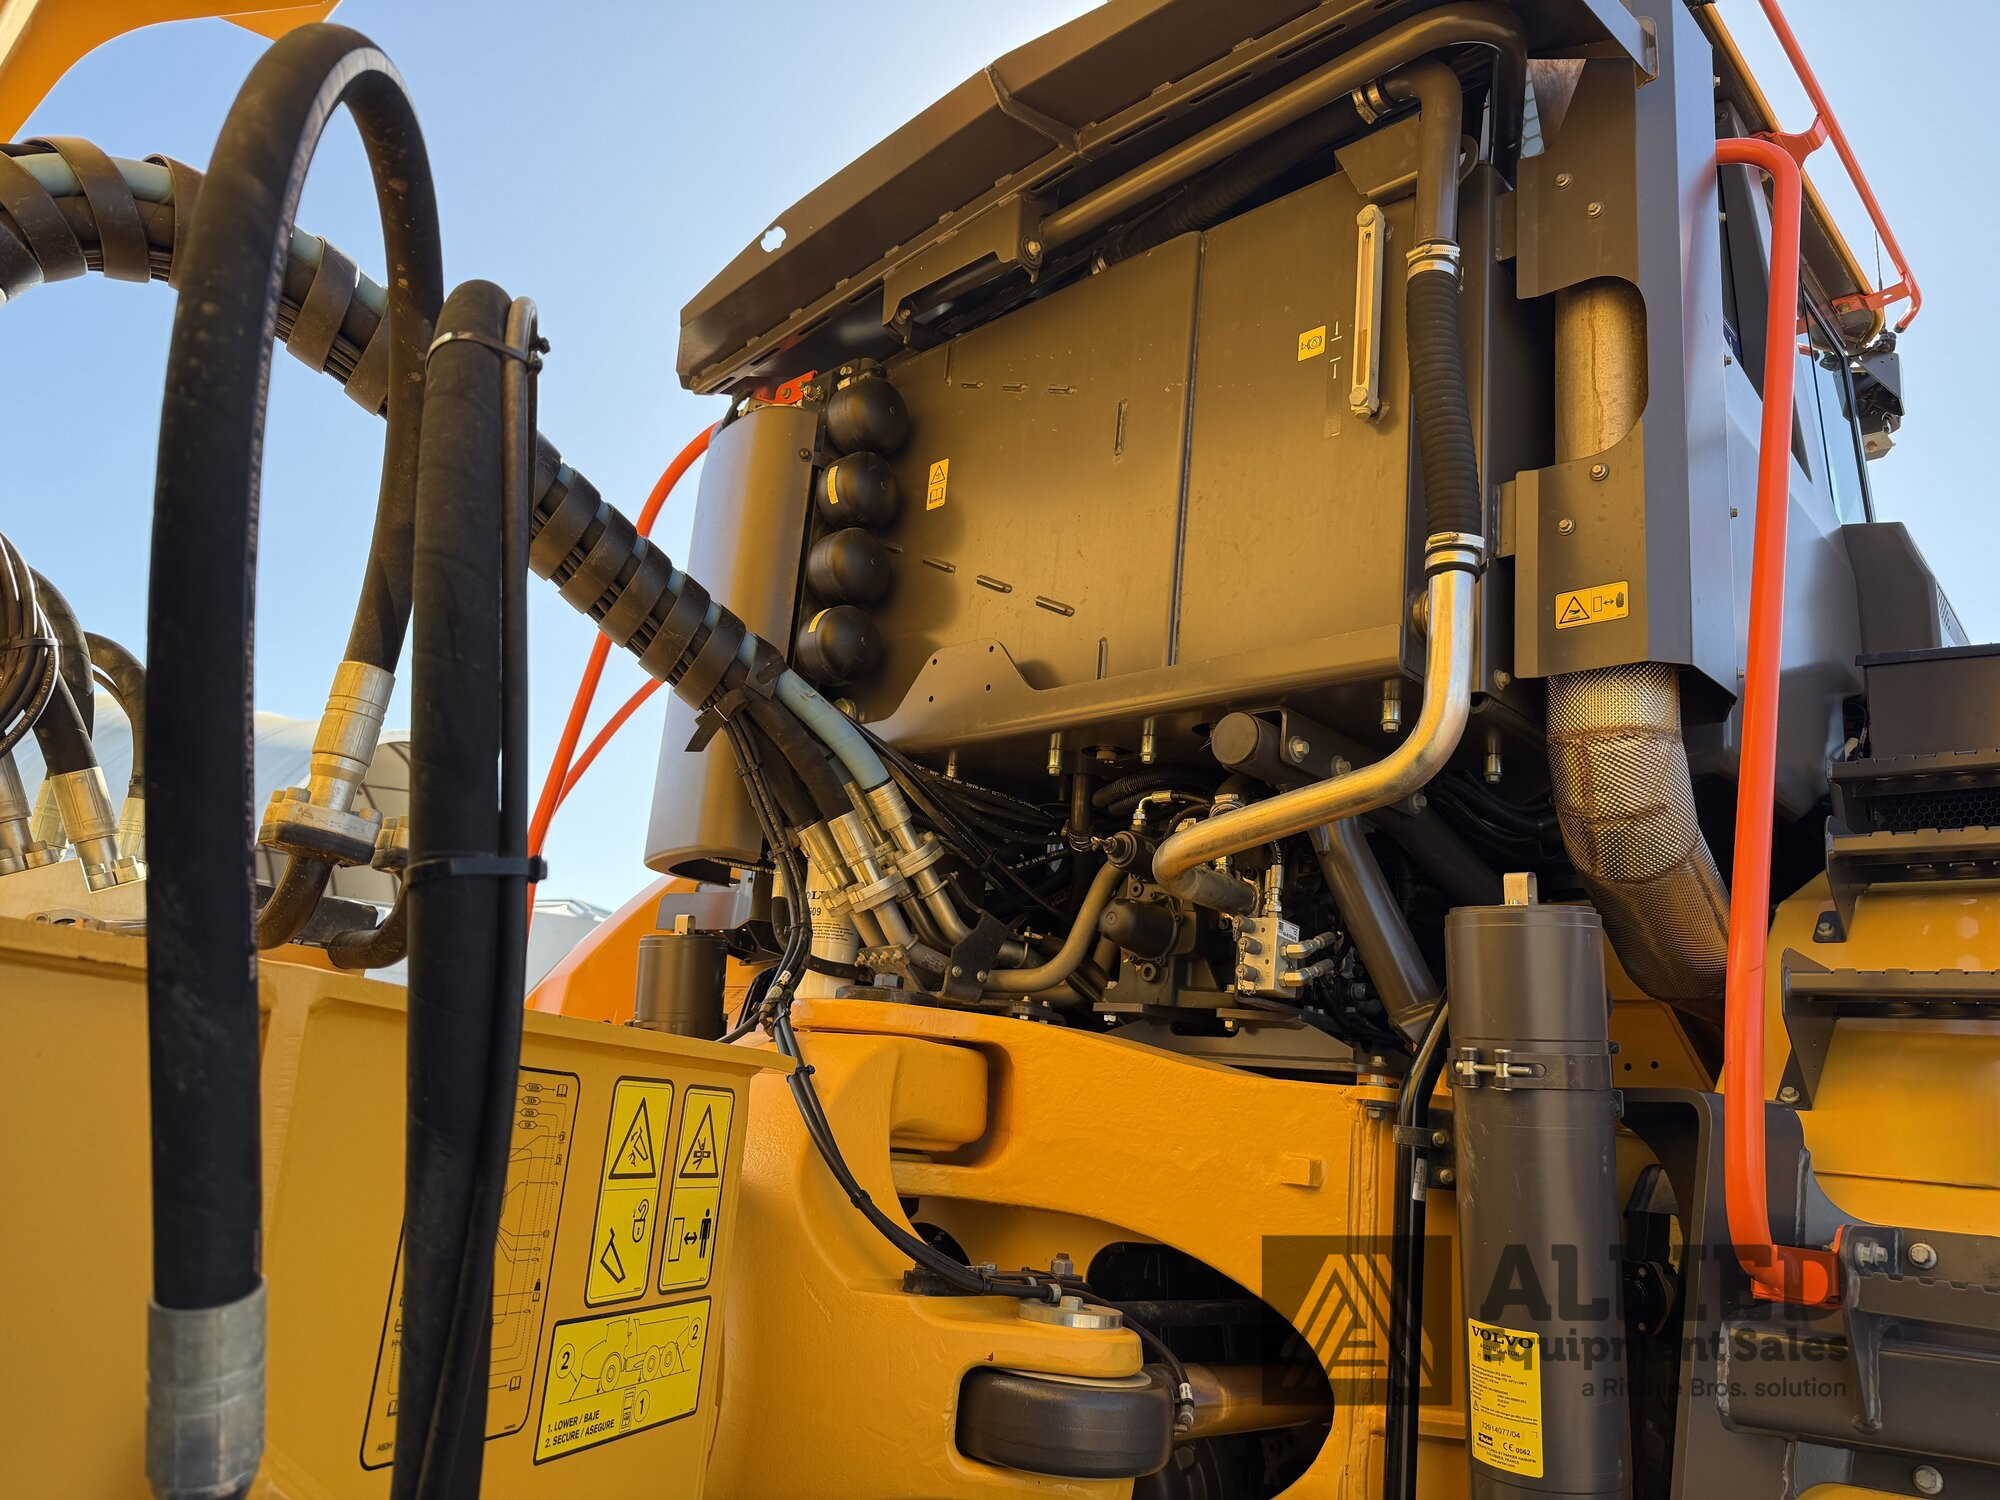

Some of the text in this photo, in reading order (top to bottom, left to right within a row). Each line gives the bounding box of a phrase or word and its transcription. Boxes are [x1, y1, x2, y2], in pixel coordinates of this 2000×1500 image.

[691, 1324, 699, 1340] 2
[1472, 1325, 1534, 1349] VOLVO
[560, 1351, 570, 1371] 2
[639, 1399, 645, 1415] 1
[554, 1415, 579, 1432] LOWER
[584, 1409, 600, 1423] BAJE
[552, 1429, 580, 1446] SECURE
[585, 1418, 615, 1437] ASEGURE
